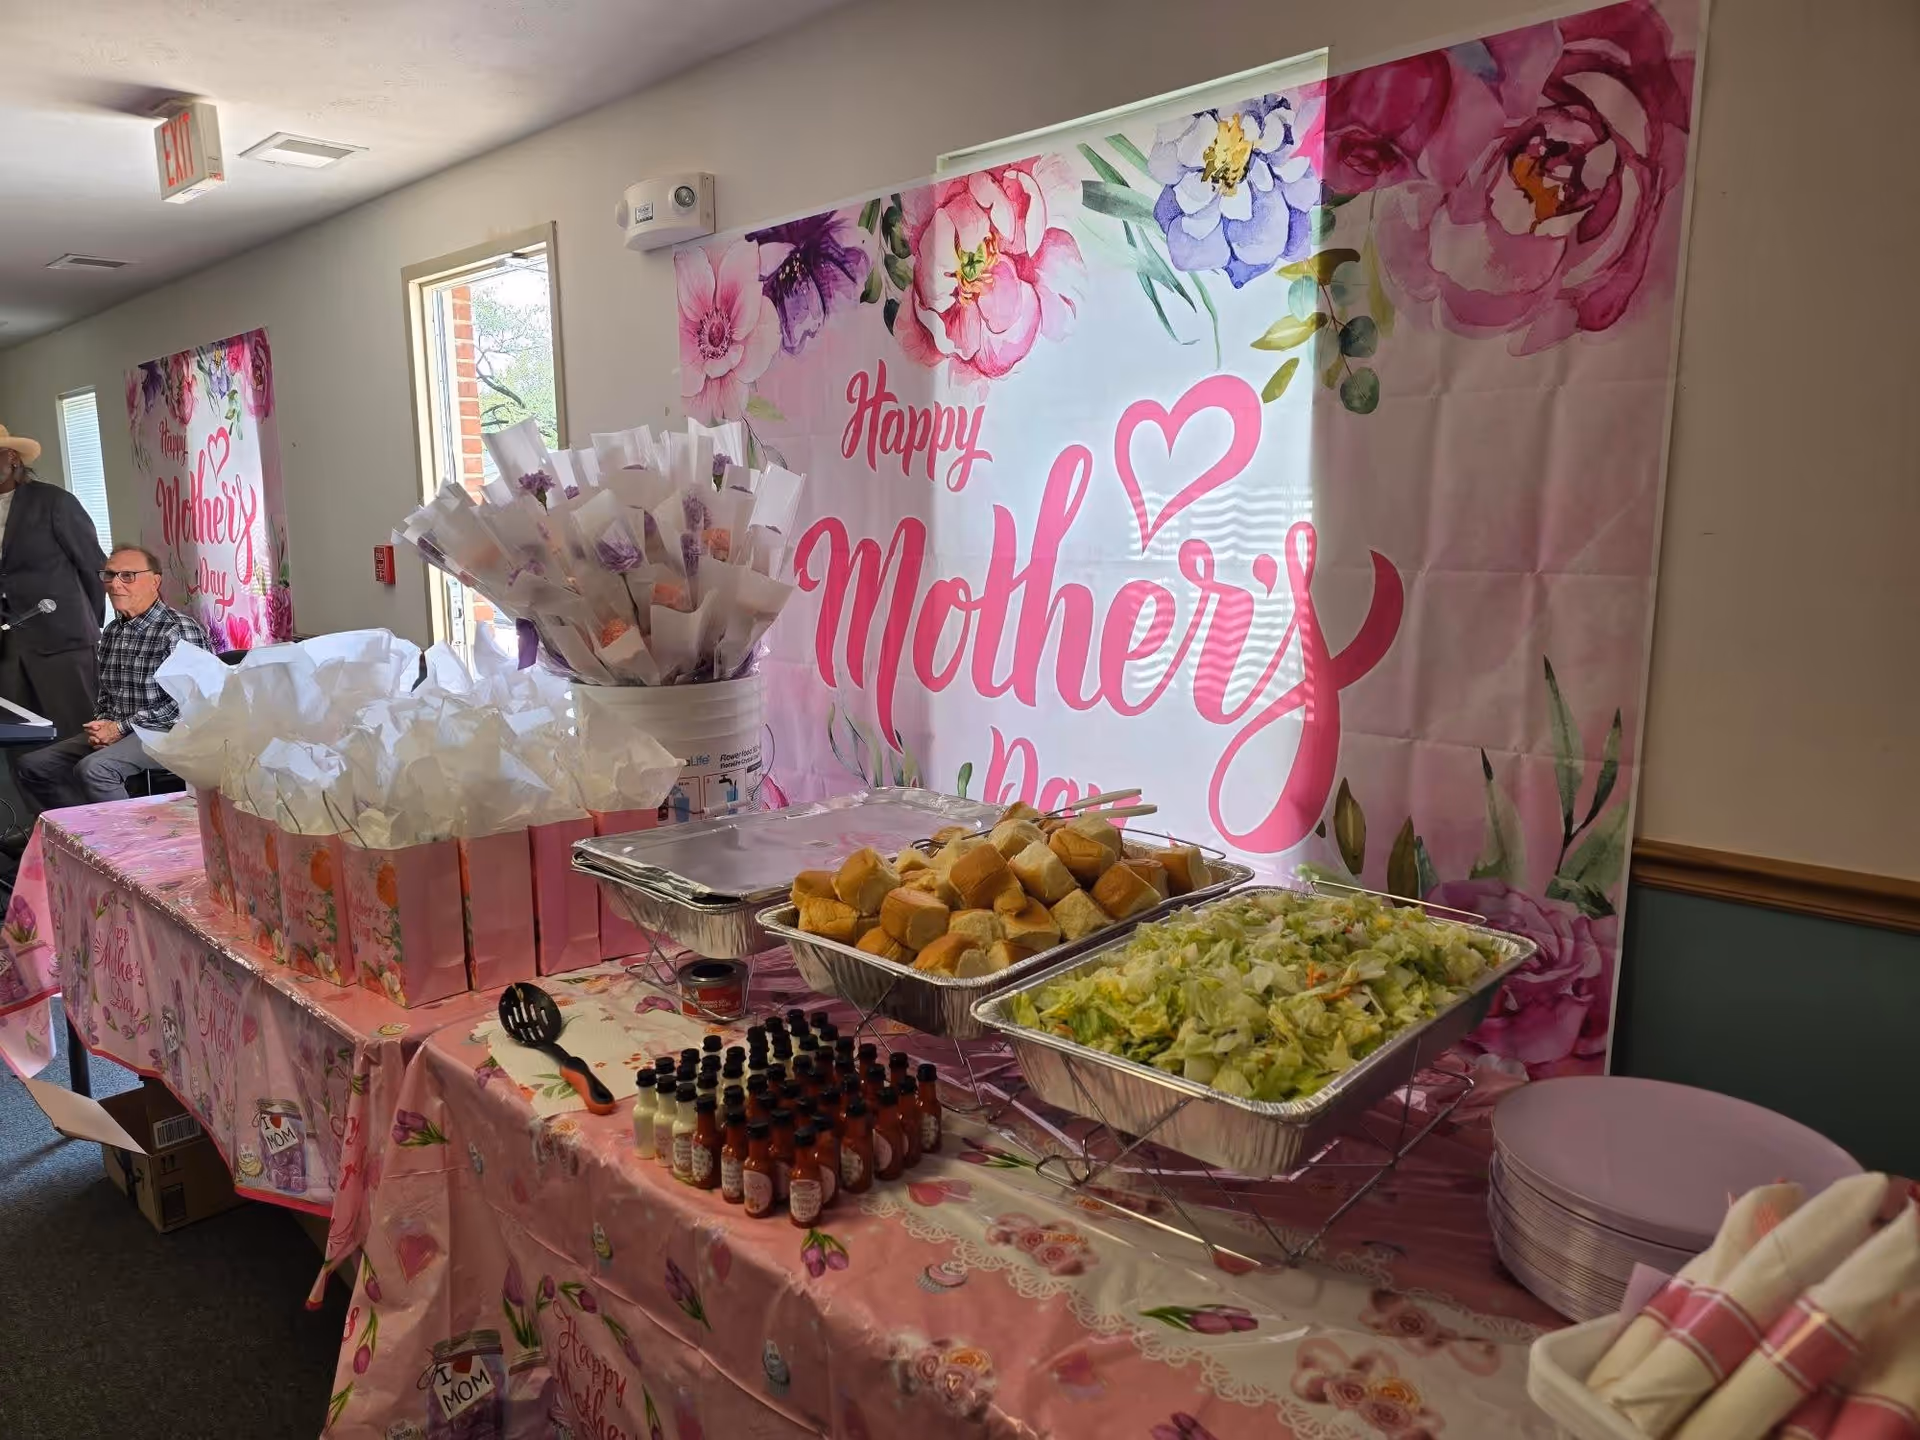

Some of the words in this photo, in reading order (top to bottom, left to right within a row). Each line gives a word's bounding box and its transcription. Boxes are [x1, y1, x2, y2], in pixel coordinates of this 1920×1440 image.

[161, 113, 194, 187] EXIT
[159, 418, 189, 466] Happy
[840, 358, 993, 492] Happy
[156, 448, 257, 585] Mother's
[187, 556, 235, 622] Day
[794, 444, 1404, 854] Mother's
[261, 1116, 270, 1130] I
[266, 1127, 297, 1150] MOM
[436, 1366, 452, 1386] I
[553, 1299, 627, 1408] Happy
[442, 1369, 490, 1412] MOM
